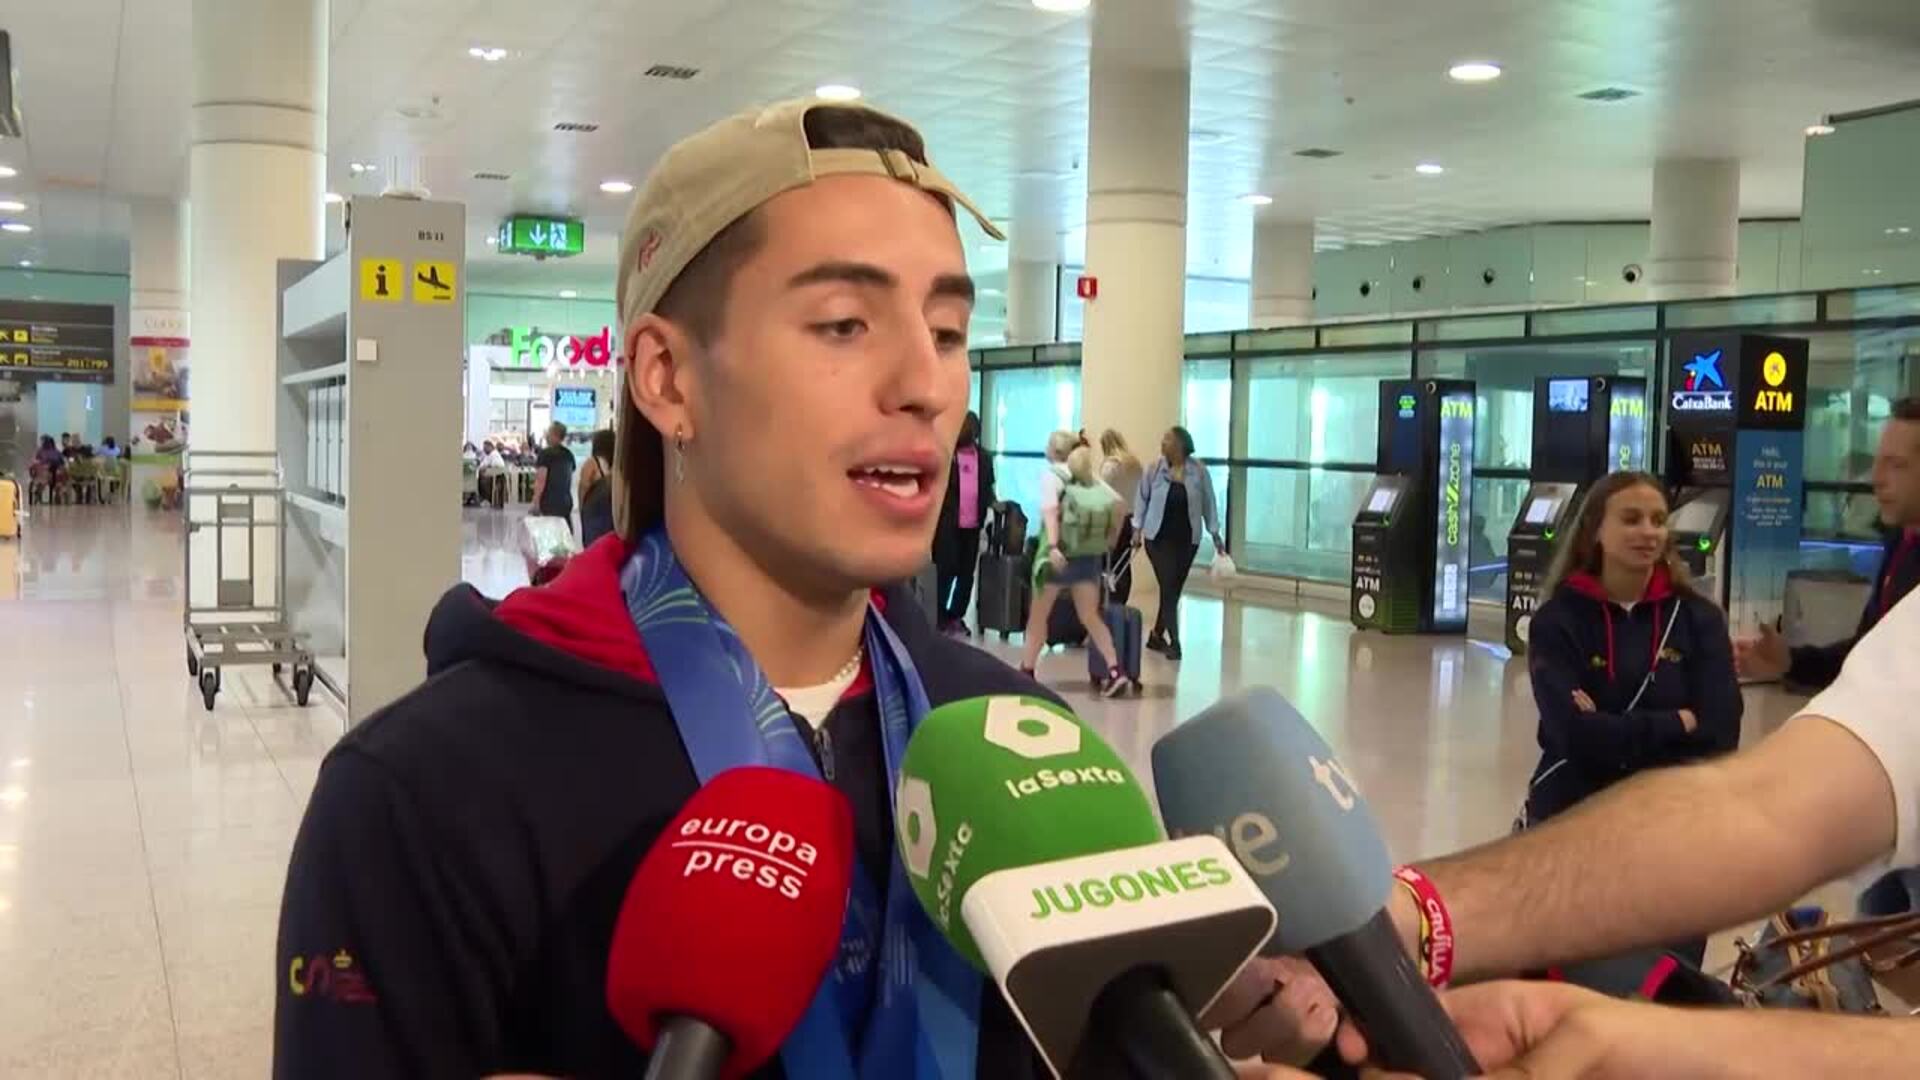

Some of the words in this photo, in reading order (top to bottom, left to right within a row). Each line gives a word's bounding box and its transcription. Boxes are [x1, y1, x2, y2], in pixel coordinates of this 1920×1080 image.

[511, 326, 611, 368] Food
[1440, 400, 1473, 419] ATM
[1610, 396, 1643, 417] ATM
[1672, 391, 1733, 411] CaixaBank
[1754, 389, 1793, 412] ATM
[1691, 442, 1723, 456] ATM
[1756, 474, 1784, 490] ATM
[1355, 575, 1380, 592] ATM
[1005, 766, 1126, 800] laSexta
[680, 817, 818, 867] europa
[683, 849, 803, 900] press
[1030, 857, 1233, 920] JUGONES
